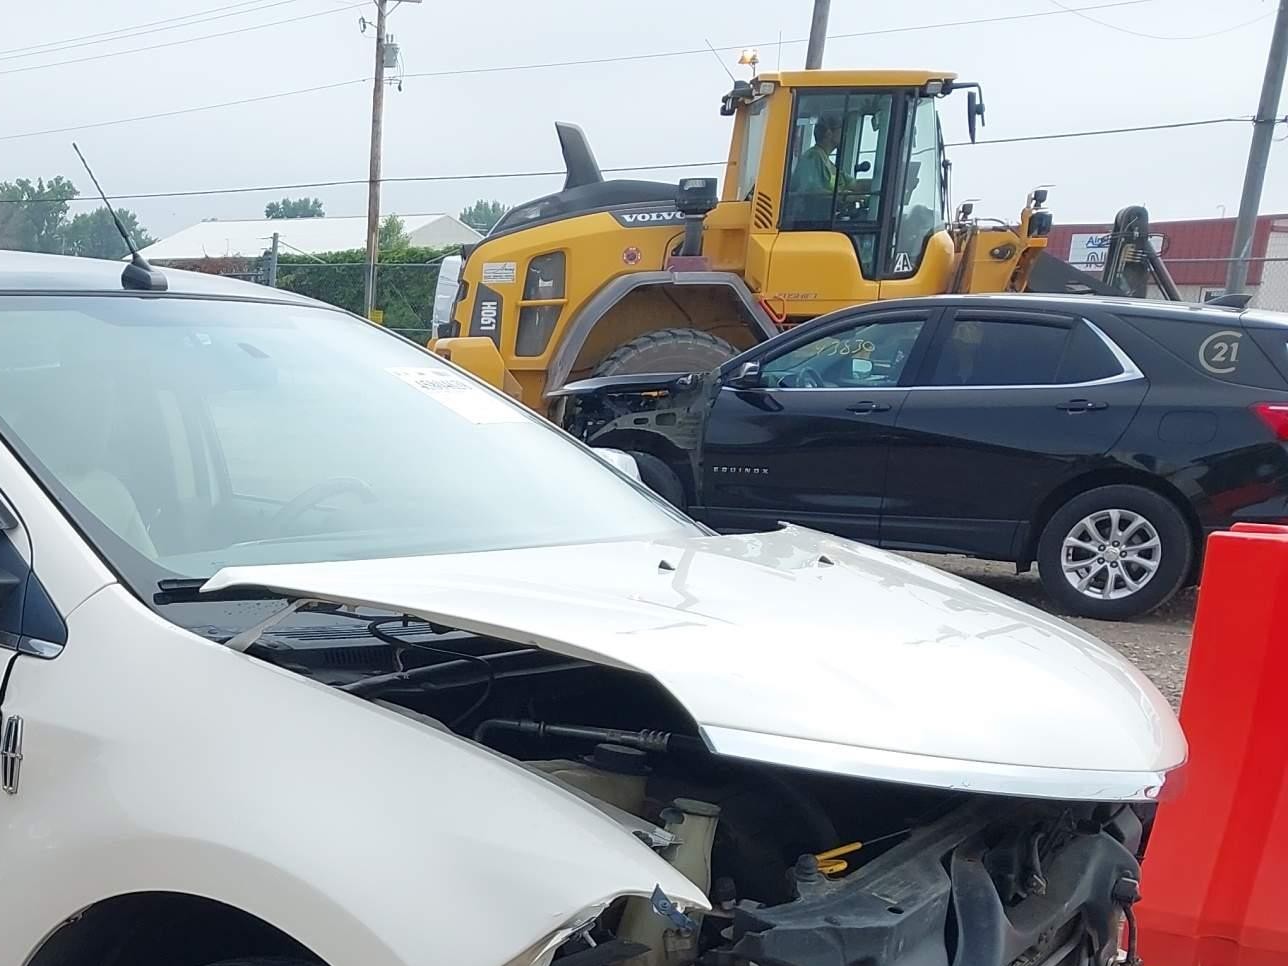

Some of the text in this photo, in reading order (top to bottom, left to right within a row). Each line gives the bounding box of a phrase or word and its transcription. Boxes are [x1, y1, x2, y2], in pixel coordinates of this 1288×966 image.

[621, 211, 686, 222] VOLVO
[480, 301, 498, 331] L90H
[713, 466, 769, 474] EQUINOX
